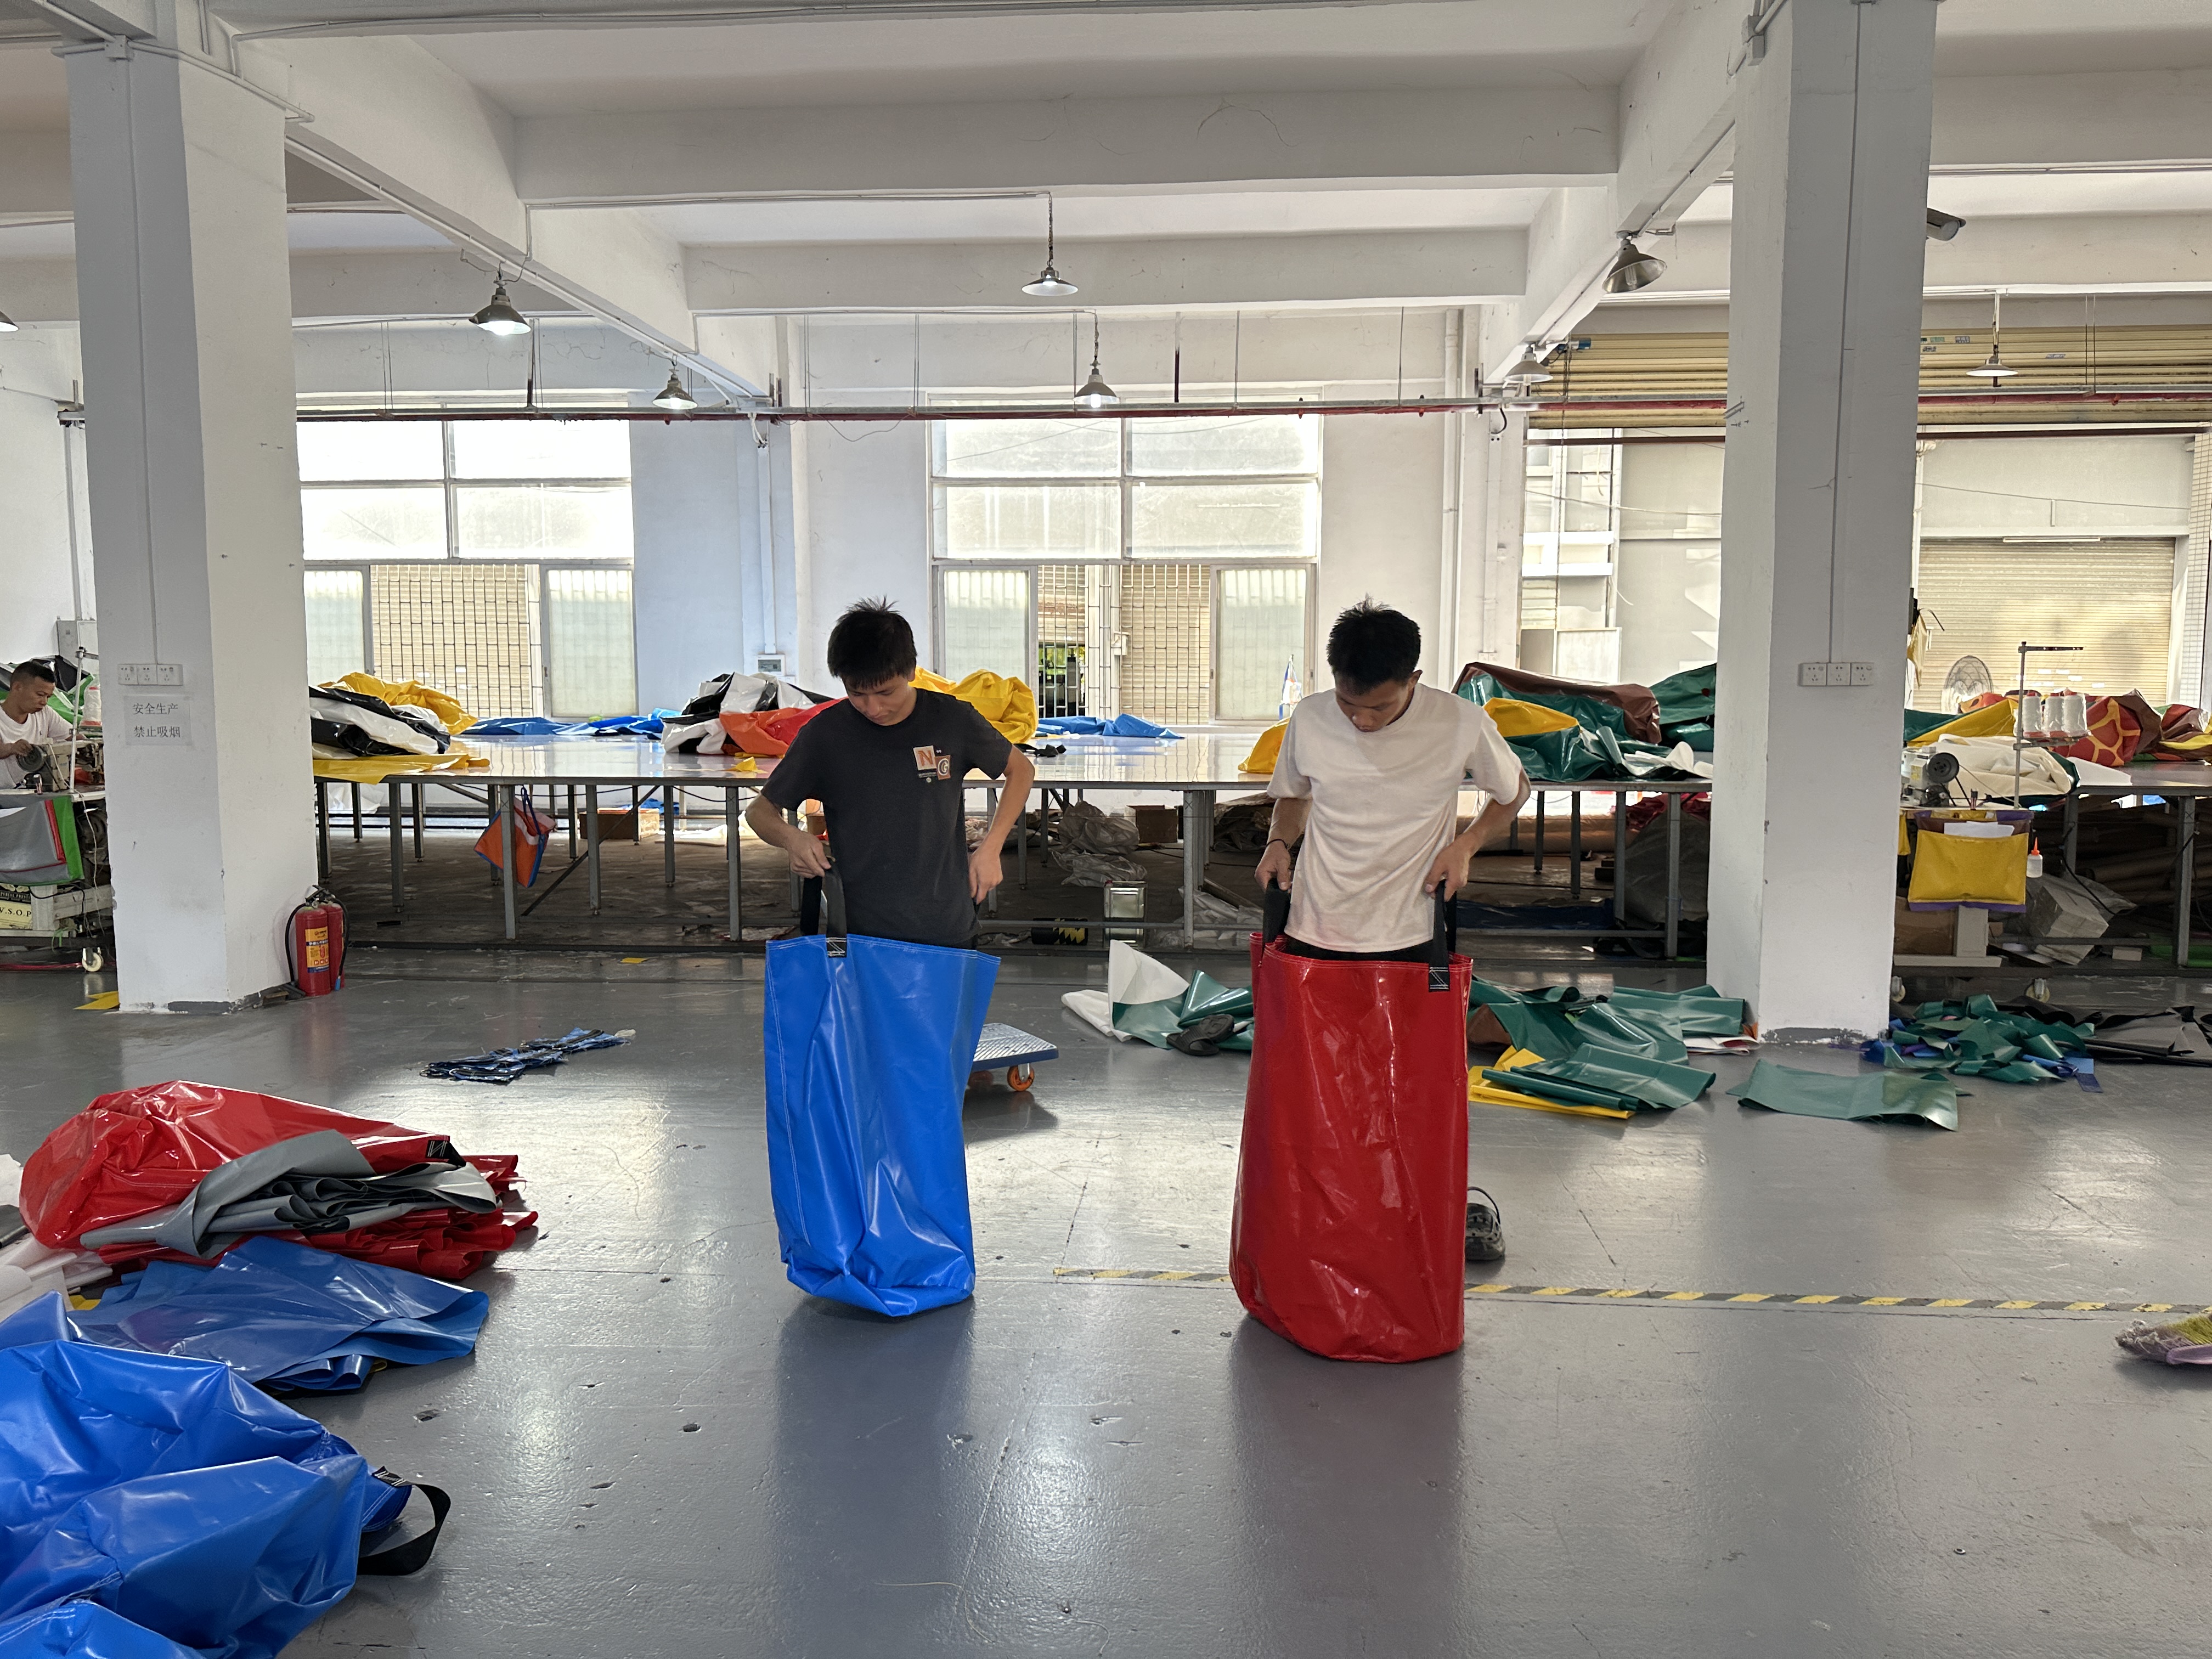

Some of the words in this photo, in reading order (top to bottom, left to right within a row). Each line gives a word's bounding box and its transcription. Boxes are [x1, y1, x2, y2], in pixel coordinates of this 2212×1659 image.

[133, 703, 178, 715] 安全生产
[133, 726, 180, 738] 禁止吸烟
[917, 750, 934, 767] N
[938, 758, 950, 776] G
